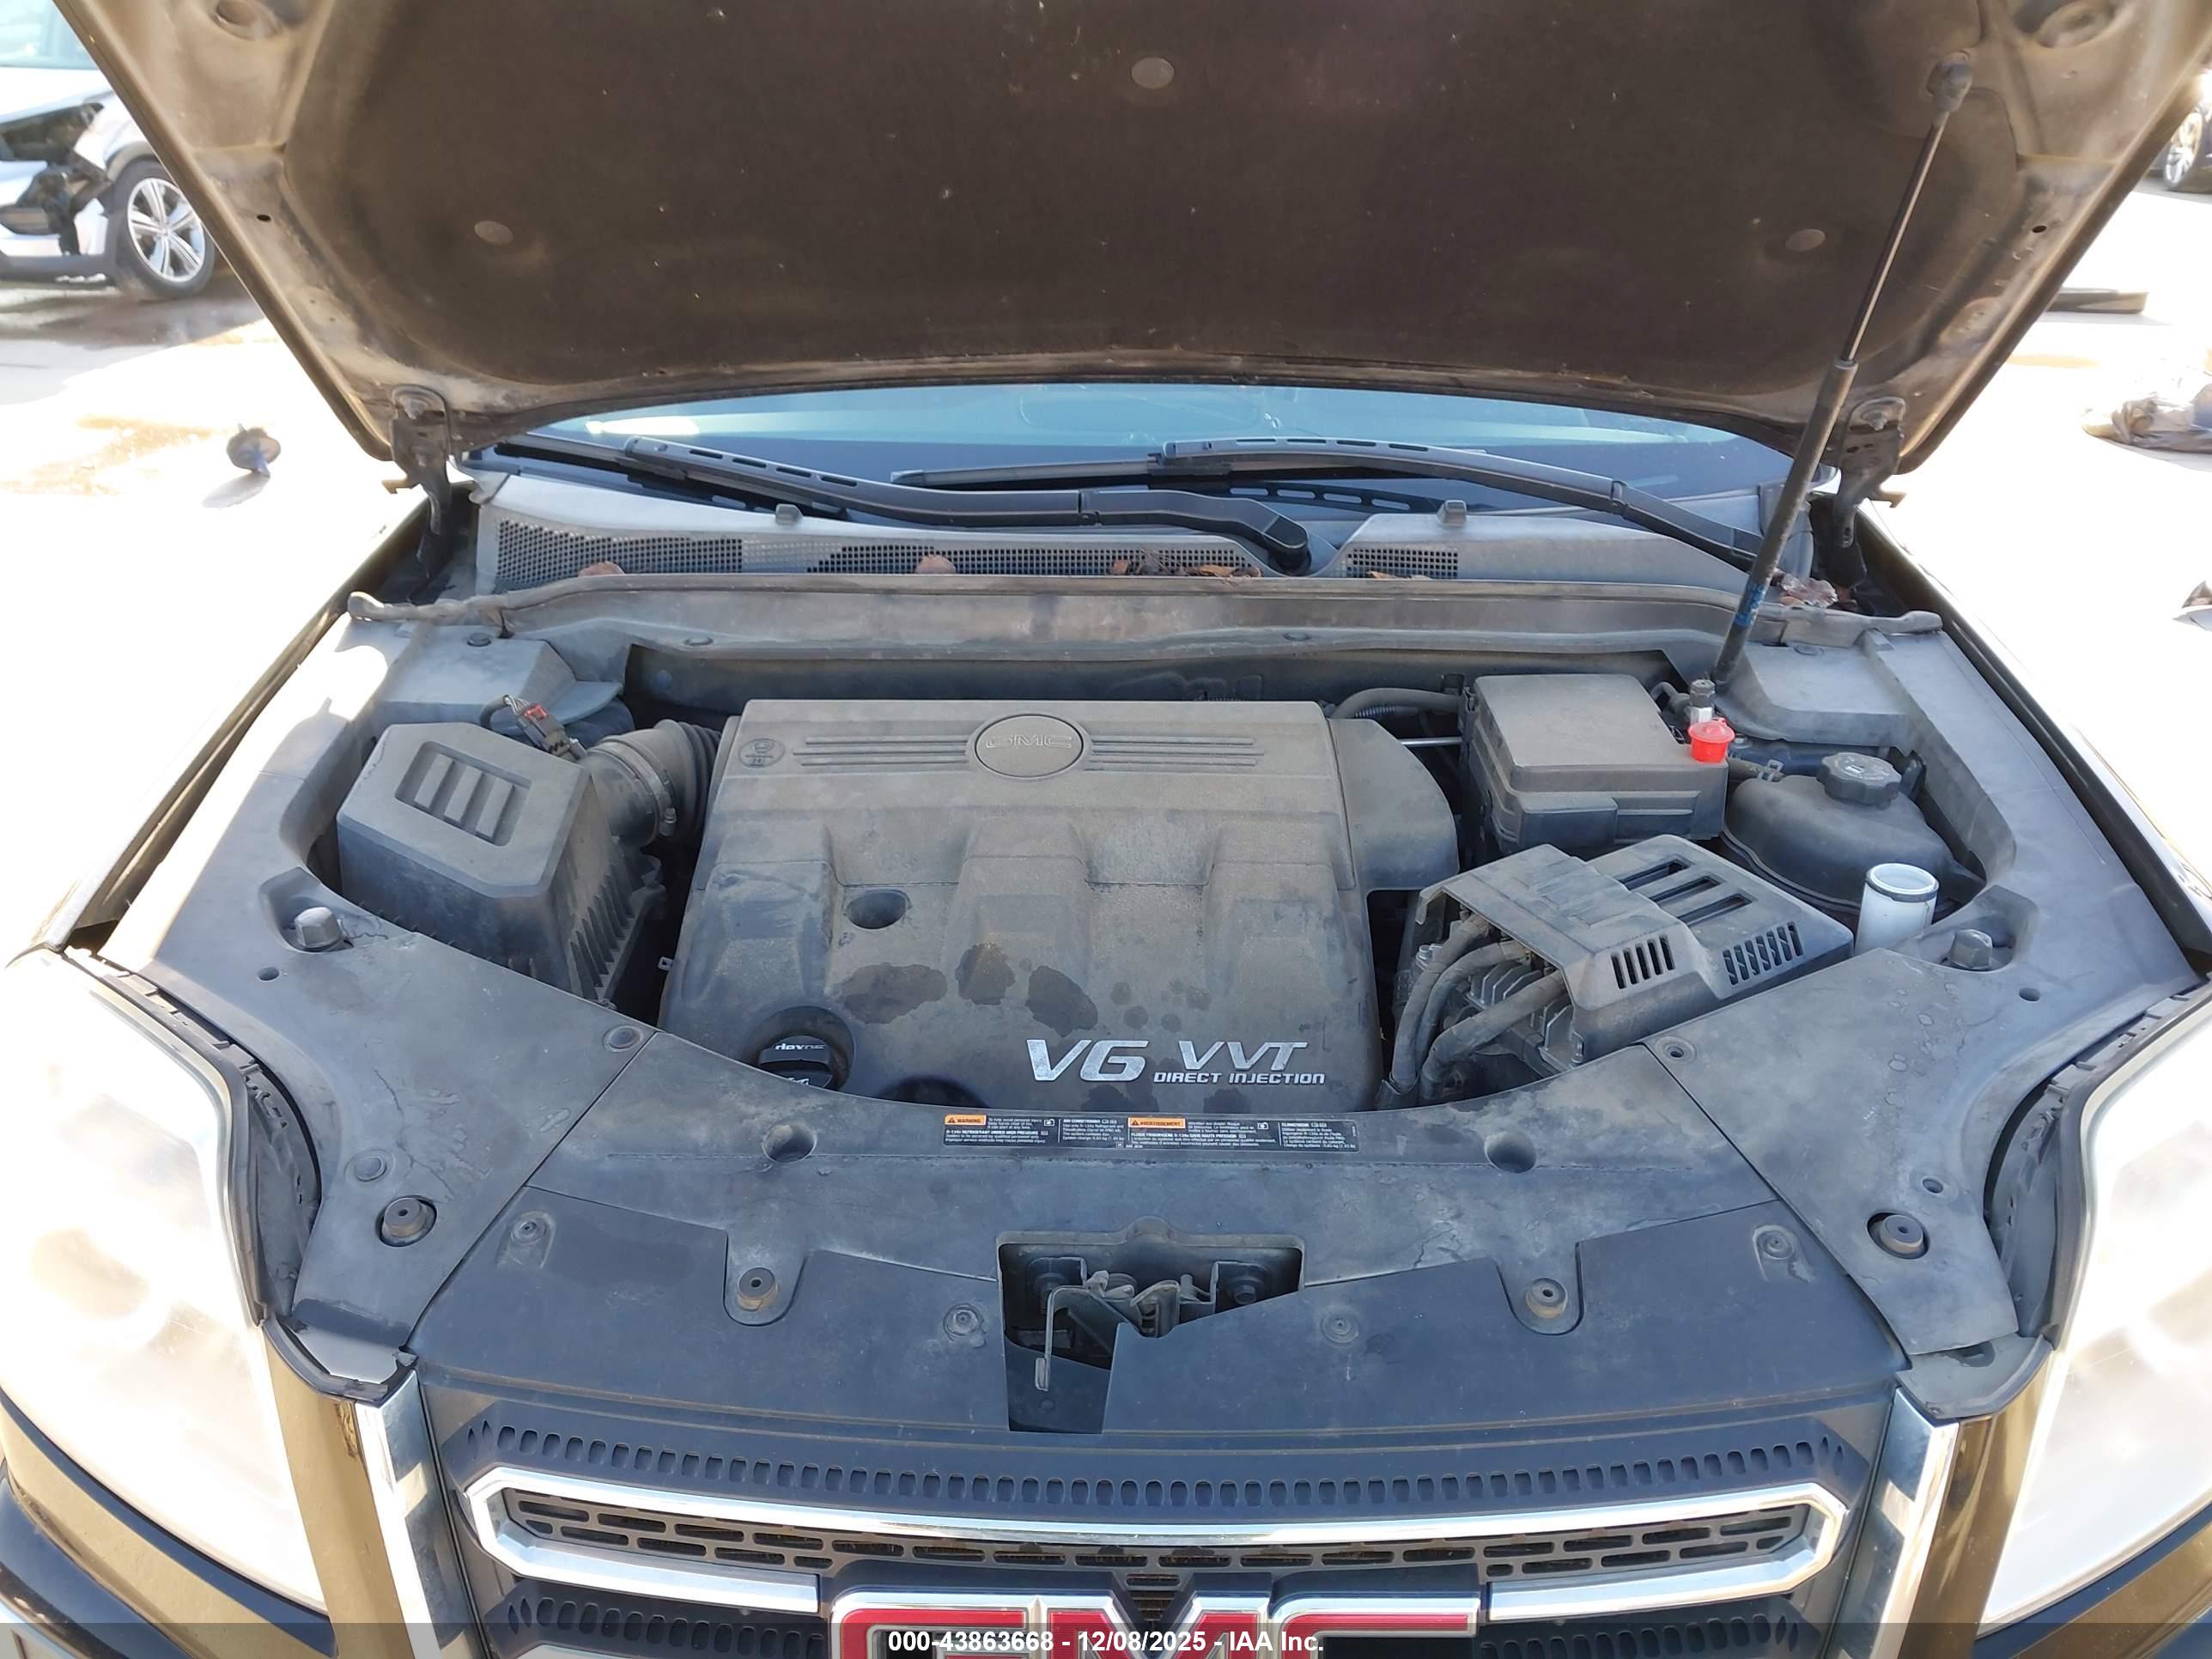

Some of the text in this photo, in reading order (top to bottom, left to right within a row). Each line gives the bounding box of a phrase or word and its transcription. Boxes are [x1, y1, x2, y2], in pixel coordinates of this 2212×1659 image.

[1026, 1039, 1309, 1082] V6 VVT
[1154, 1073, 1326, 1085] DIRECT INJECTION
